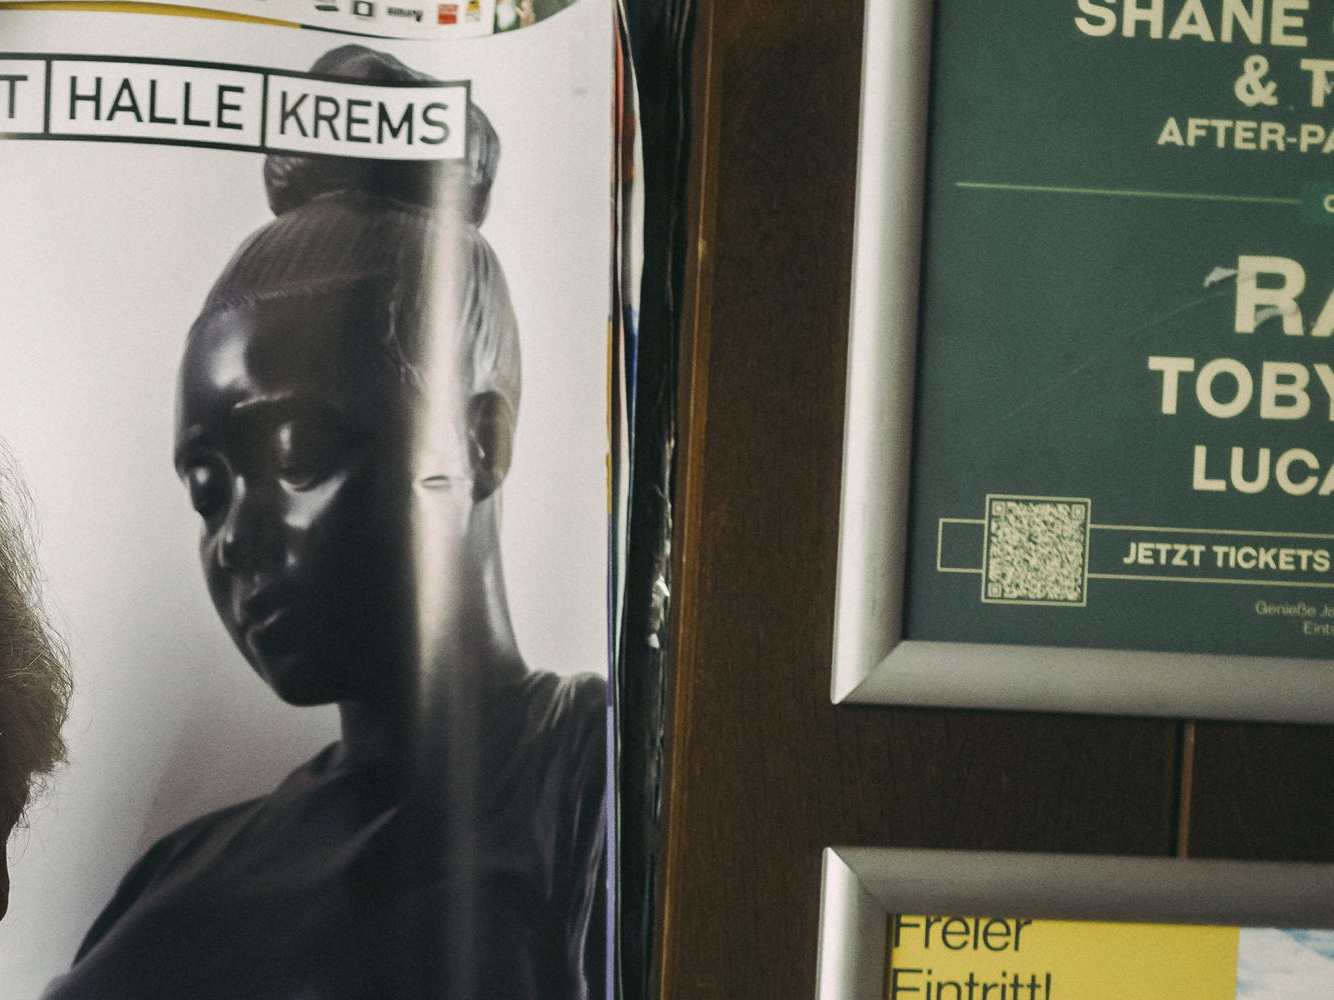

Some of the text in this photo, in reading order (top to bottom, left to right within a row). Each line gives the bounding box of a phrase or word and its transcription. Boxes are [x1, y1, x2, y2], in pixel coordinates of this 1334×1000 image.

[1074, 0, 1309, 47] SHANE
[1234, 54, 1279, 108] &
[68, 76, 247, 132] HALLE
[278, 92, 452, 147] KREMS
[1123, 541, 1330, 572] JETZT TICKETS
[893, 915, 1033, 951] Freier
